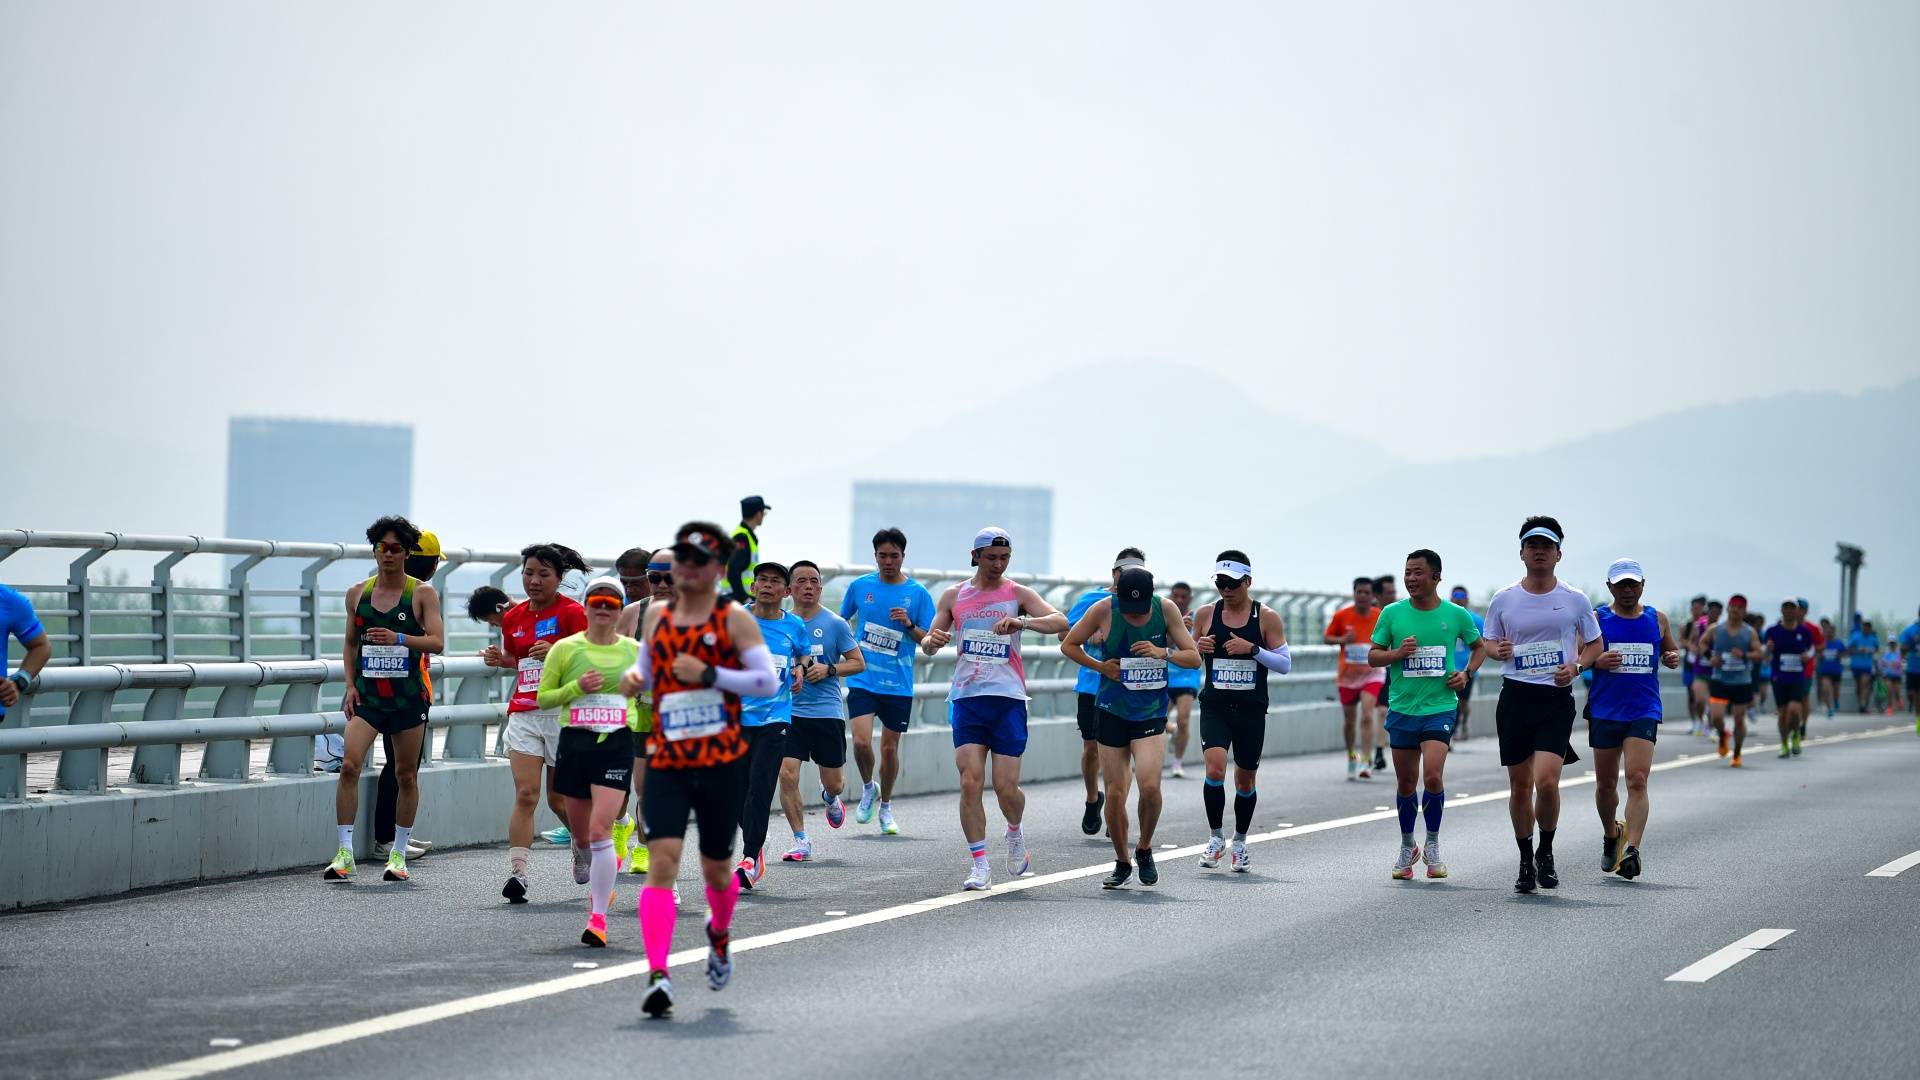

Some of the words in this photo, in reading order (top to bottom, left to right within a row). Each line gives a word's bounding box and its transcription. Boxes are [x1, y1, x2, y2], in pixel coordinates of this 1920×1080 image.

[867, 633, 897, 649] A00979
[969, 641, 1006, 656] A02294
[367, 657, 404, 669] A01592
[1408, 657, 1443, 669] A01868
[1522, 652, 1560, 667] A01565
[1127, 668, 1164, 681] A02232
[1217, 670, 1254, 682] A00649
[577, 708, 622, 722] A50319
